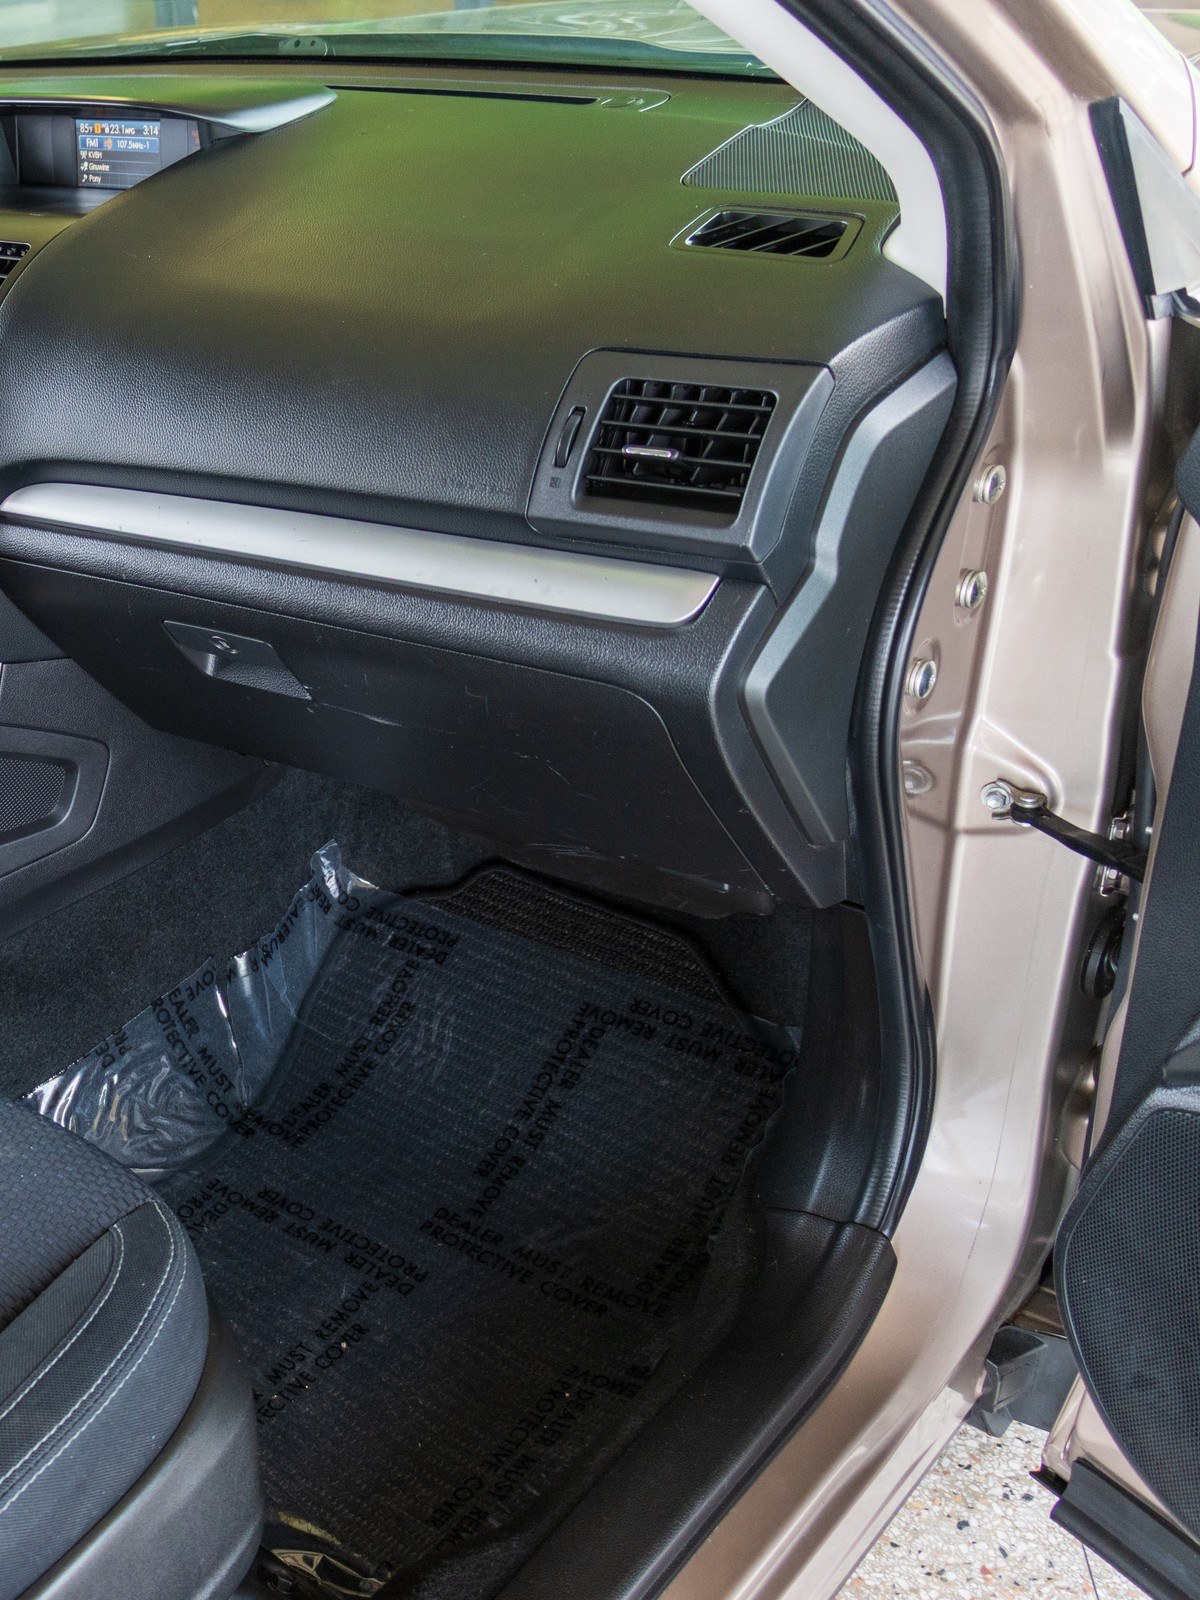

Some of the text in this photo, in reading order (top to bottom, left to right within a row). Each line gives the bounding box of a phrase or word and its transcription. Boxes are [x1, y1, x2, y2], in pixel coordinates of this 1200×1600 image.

[143, 125, 159, 135] 3:14
[364, 905, 460, 949] PROTECTIVE
[388, 933, 448, 966] DEALER
[369, 957, 420, 1027] REMOVE
[629, 997, 693, 1030] COVER
[373, 998, 418, 1056] COVER
[576, 1001, 657, 1041] REMOVE
[199, 1046, 236, 1095] MUST
[665, 1035, 723, 1062] MUST
[466, 1026, 606, 1218] DEALER MUST REMOVE
[473, 1019, 585, 1181] PROTECTIVE COVER
[205, 1177, 280, 1224] REMOVE
[256, 1185, 315, 1221] COVER
[283, 1222, 337, 1251] MUST
[318, 1217, 429, 1284] PROTECTIVE
[433, 1206, 505, 1247] DEALER
[344, 1252, 415, 1296] DEALER
[418, 1219, 608, 1317] PROTECTIVE COVER
[265, 1280, 380, 1386] MUST REMOVE
[315, 1322, 370, 1371] COVER
[539, 1387, 598, 1447] DEALER
[423, 1378, 573, 1530] PROTECTIVE COVER
[490, 1451, 538, 1501] MUST
